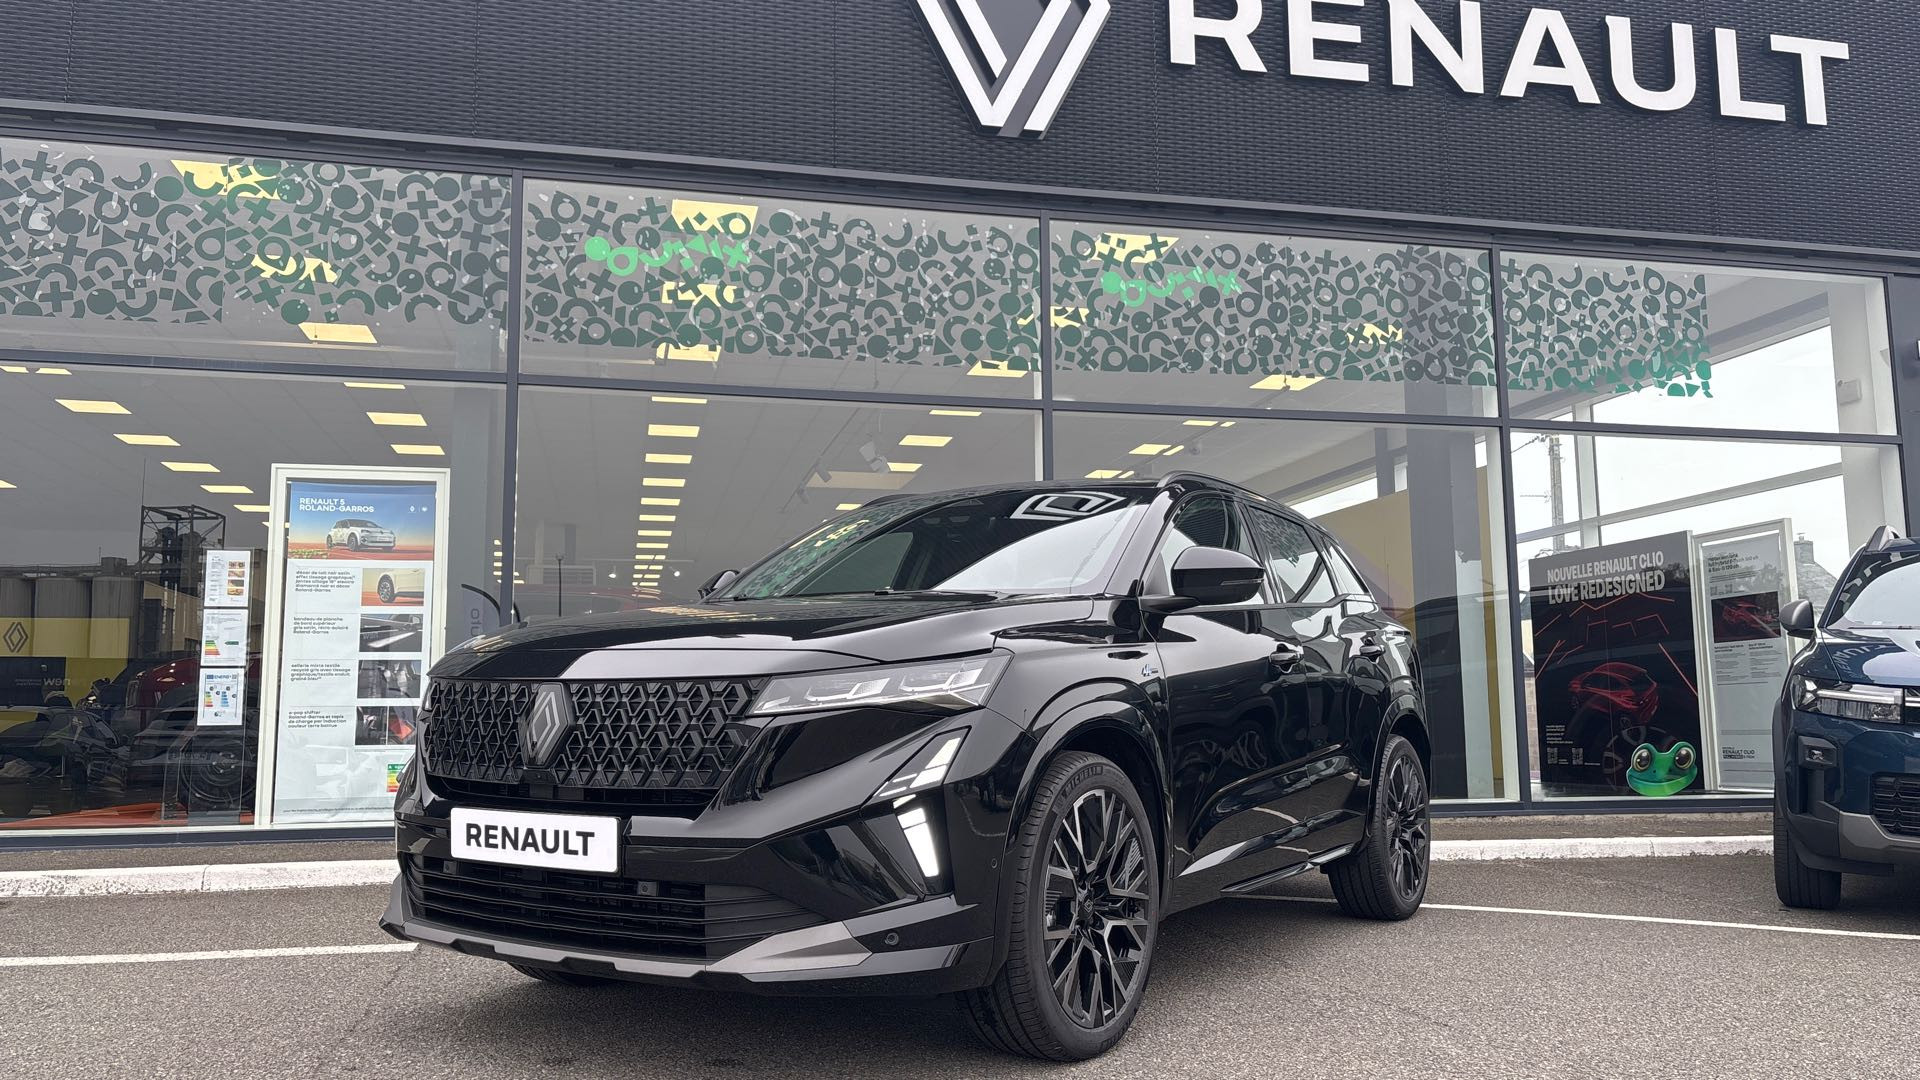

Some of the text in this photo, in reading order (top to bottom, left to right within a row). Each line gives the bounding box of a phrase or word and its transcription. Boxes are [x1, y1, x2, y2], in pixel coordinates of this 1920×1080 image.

[1168, 0, 1850, 126] RENAULT
[299, 497, 338, 506] RENAULT
[299, 504, 375, 513] ROLAND-GARROS
[1547, 550, 1665, 583] NOUVELLE RENAULT CLIO
[1548, 569, 1666, 605] LOVE REDESIGNED
[465, 822, 595, 857] RENAULT
